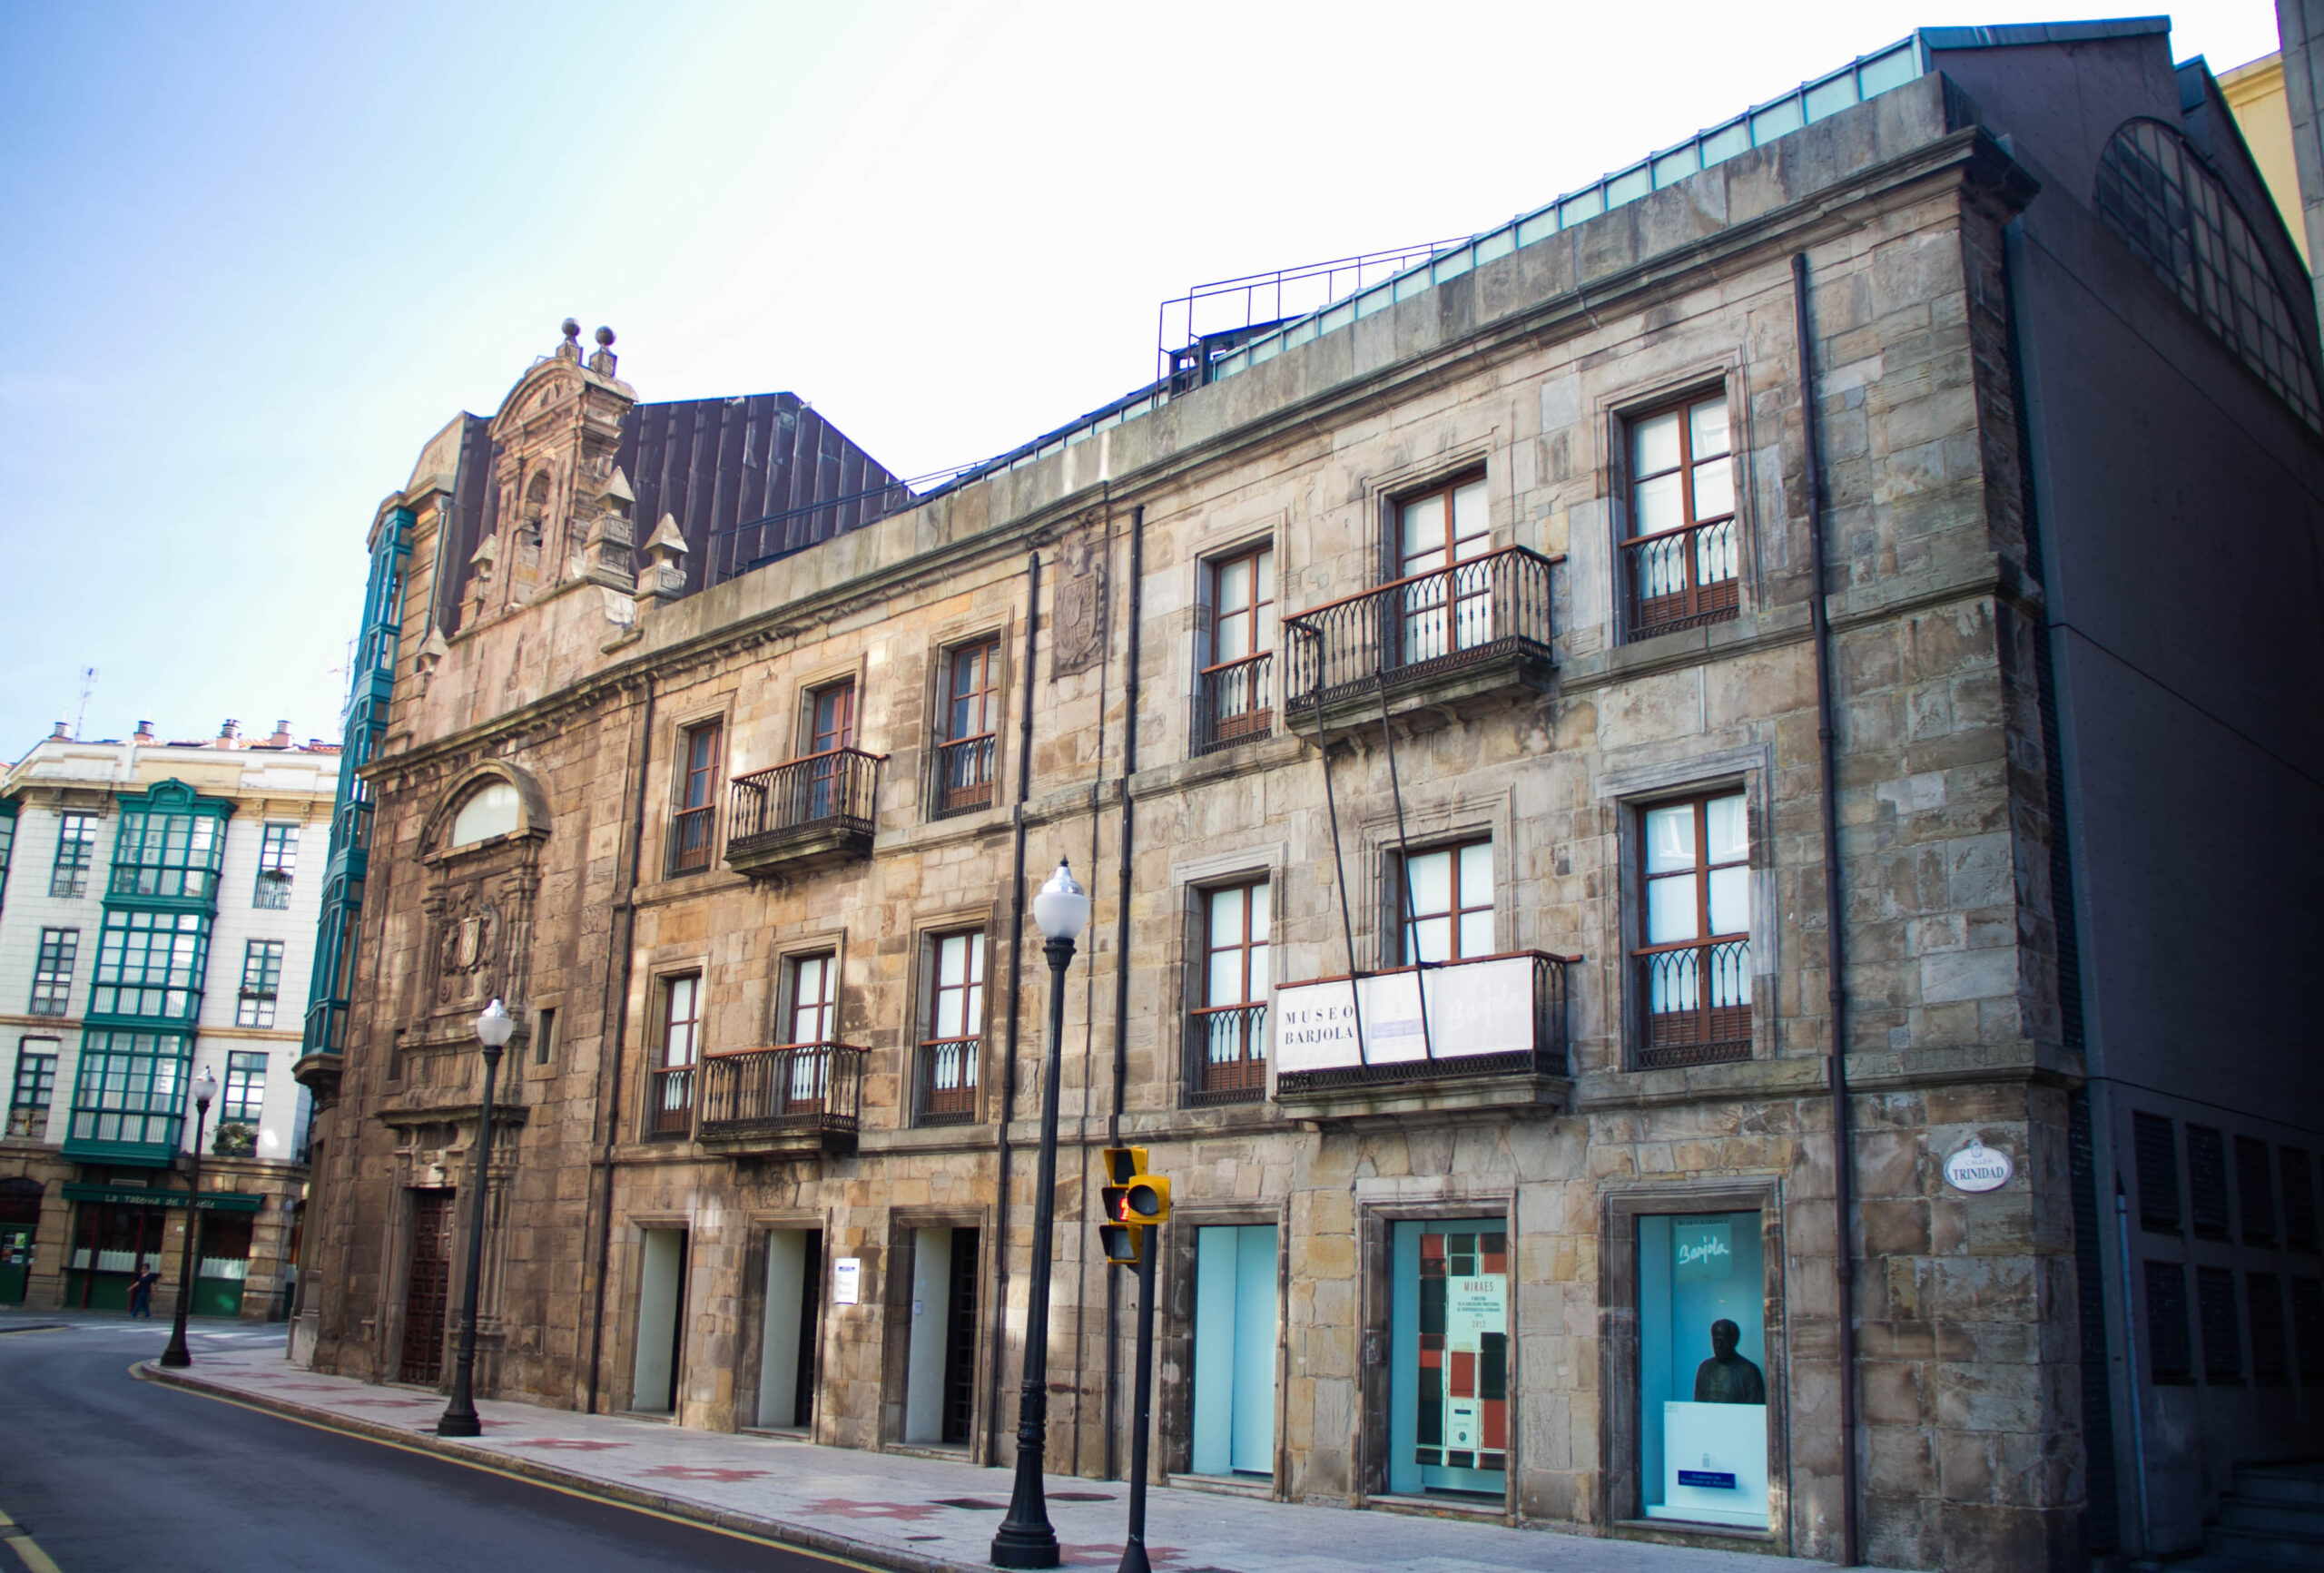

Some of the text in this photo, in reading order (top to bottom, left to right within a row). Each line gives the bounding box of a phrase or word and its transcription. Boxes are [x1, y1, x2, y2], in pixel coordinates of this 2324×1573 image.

[1285, 1005, 1354, 1026] MUSEO
[1285, 1027, 1354, 1046] BARJOLA
[1953, 1165, 2004, 1180] TRINIDAD
[105, 1194, 118, 1203] La
[123, 1194, 160, 1205] Taberna
[165, 1197, 179, 1206] del
[1679, 1235, 1729, 1264] Barjola
[1464, 1281, 1494, 1293] MIRAES
